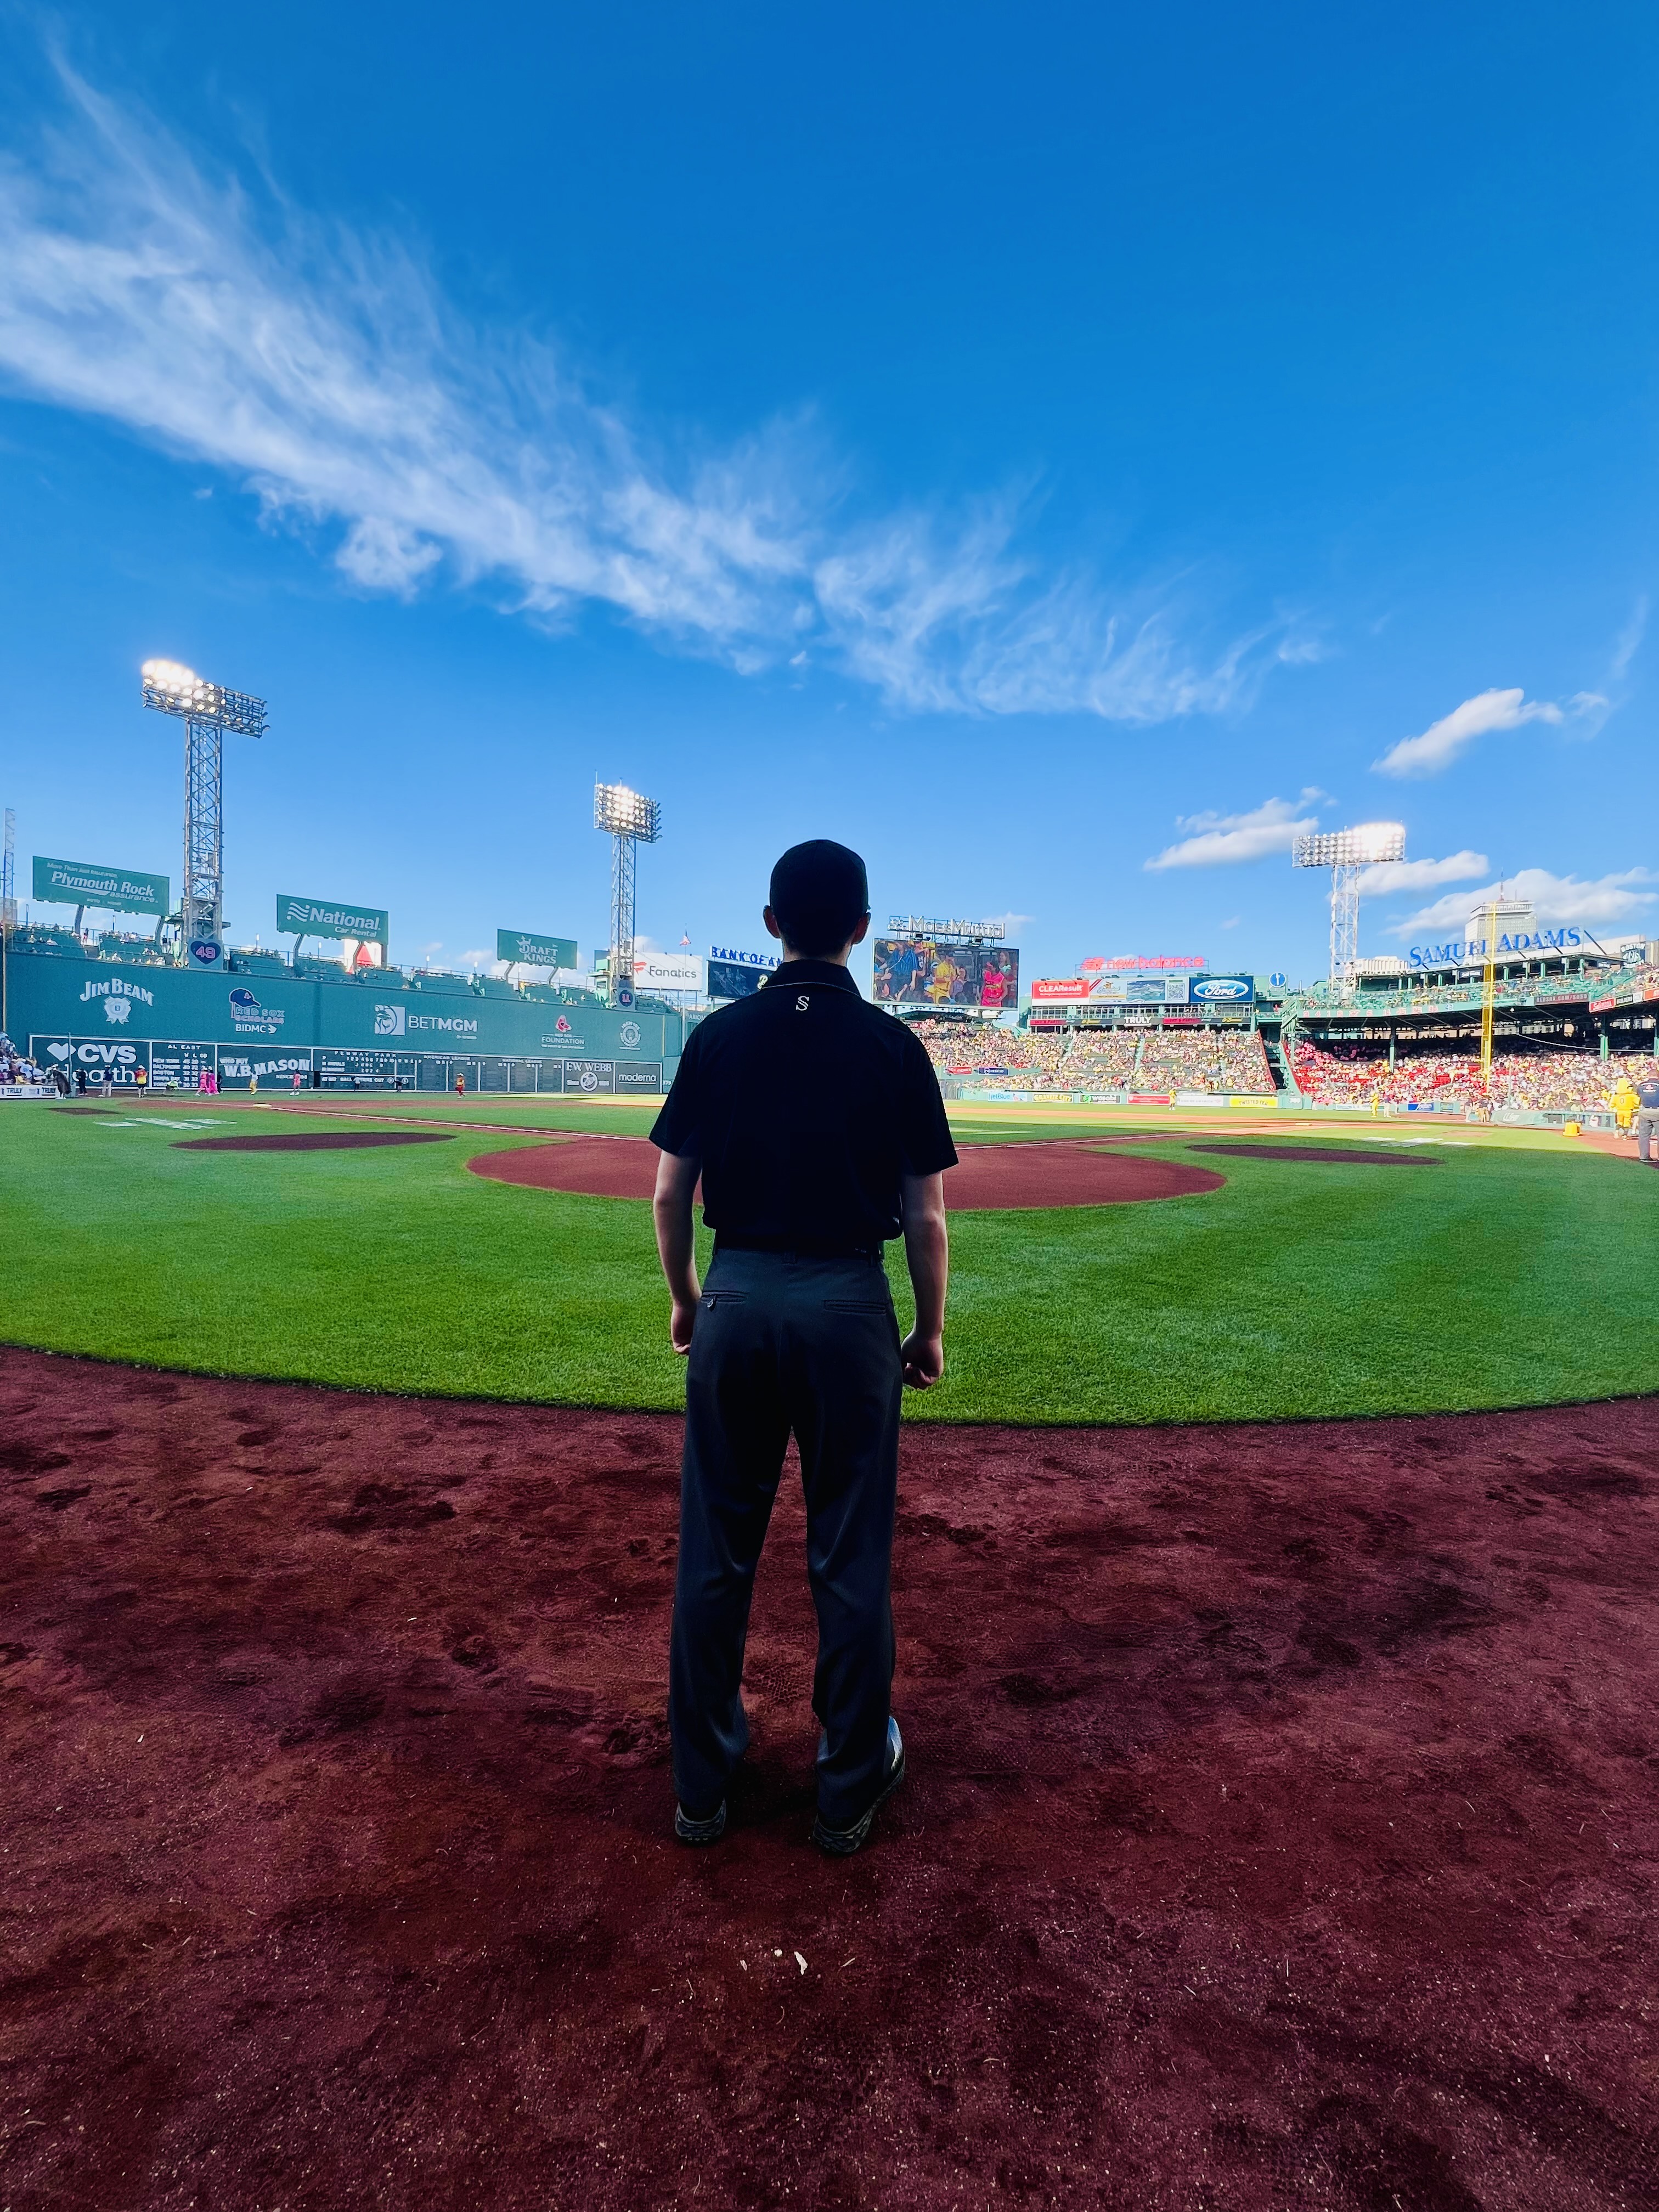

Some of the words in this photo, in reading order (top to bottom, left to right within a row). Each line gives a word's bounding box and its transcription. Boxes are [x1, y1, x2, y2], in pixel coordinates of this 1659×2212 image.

[51, 871, 117, 891] Plymouth
[121, 881, 155, 897] Rock
[309, 907, 380, 930] National
[334, 926, 349, 934] Car
[351, 928, 377, 938] Rental
[909, 915, 1006, 940] MassMutual
[1497, 926, 1581, 951] ADAMS
[195, 946, 216, 960] 49
[518, 944, 558, 956] DRAFT
[712, 946, 746, 962] BANK
[750, 953, 765, 965] OF
[523, 952, 557, 964] KINGS
[1107, 958, 1137, 969] new
[1138, 955, 1204, 969] balance
[650, 966, 697, 978] Fanatics
[80, 980, 110, 1002] JIM
[110, 978, 155, 1007] BEAM
[1204, 982, 1238, 996] Ford
[795, 996, 810, 1011] S
[235, 1015, 285, 1024] SCHOLARS
[236, 1007, 259, 1016] RED
[262, 1009, 285, 1018] SOX
[235, 1024, 267, 1033] BIDMC
[408, 1015, 477, 1032] BETMGM
[541, 1036, 585, 1045] FOUNDATION
[77, 1043, 137, 1064] CVS
[253, 1059, 311, 1076] MASON
[584, 1062, 612, 1072] WEBB
[618, 1073, 657, 1082] moderna
[1034, 1093, 1059, 1102] GRANITE
[1059, 1094, 1072, 1102] CITY
